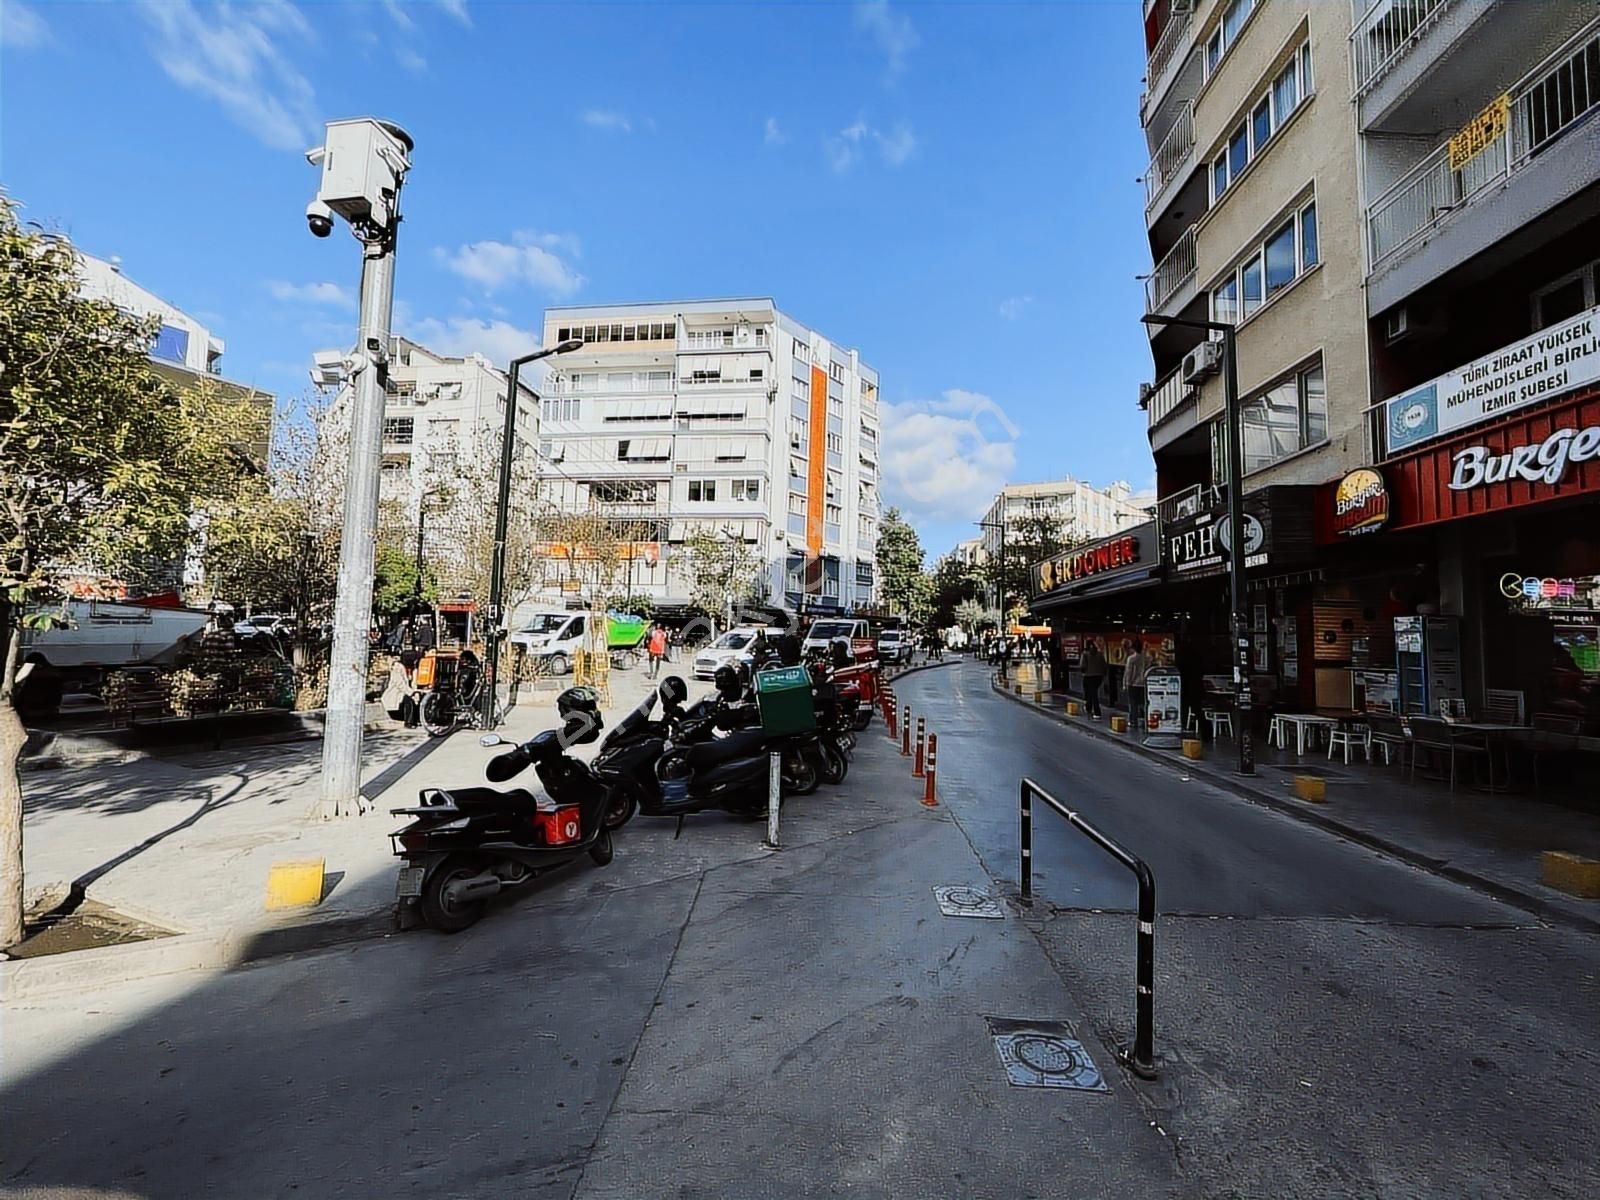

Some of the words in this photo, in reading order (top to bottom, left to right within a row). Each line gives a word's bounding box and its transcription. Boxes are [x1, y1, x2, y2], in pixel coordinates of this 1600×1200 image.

[1493, 344, 1535, 373] ZİRAAT
[1554, 336, 1600, 367] BİRLİ
[1447, 426, 1600, 490] Burge
